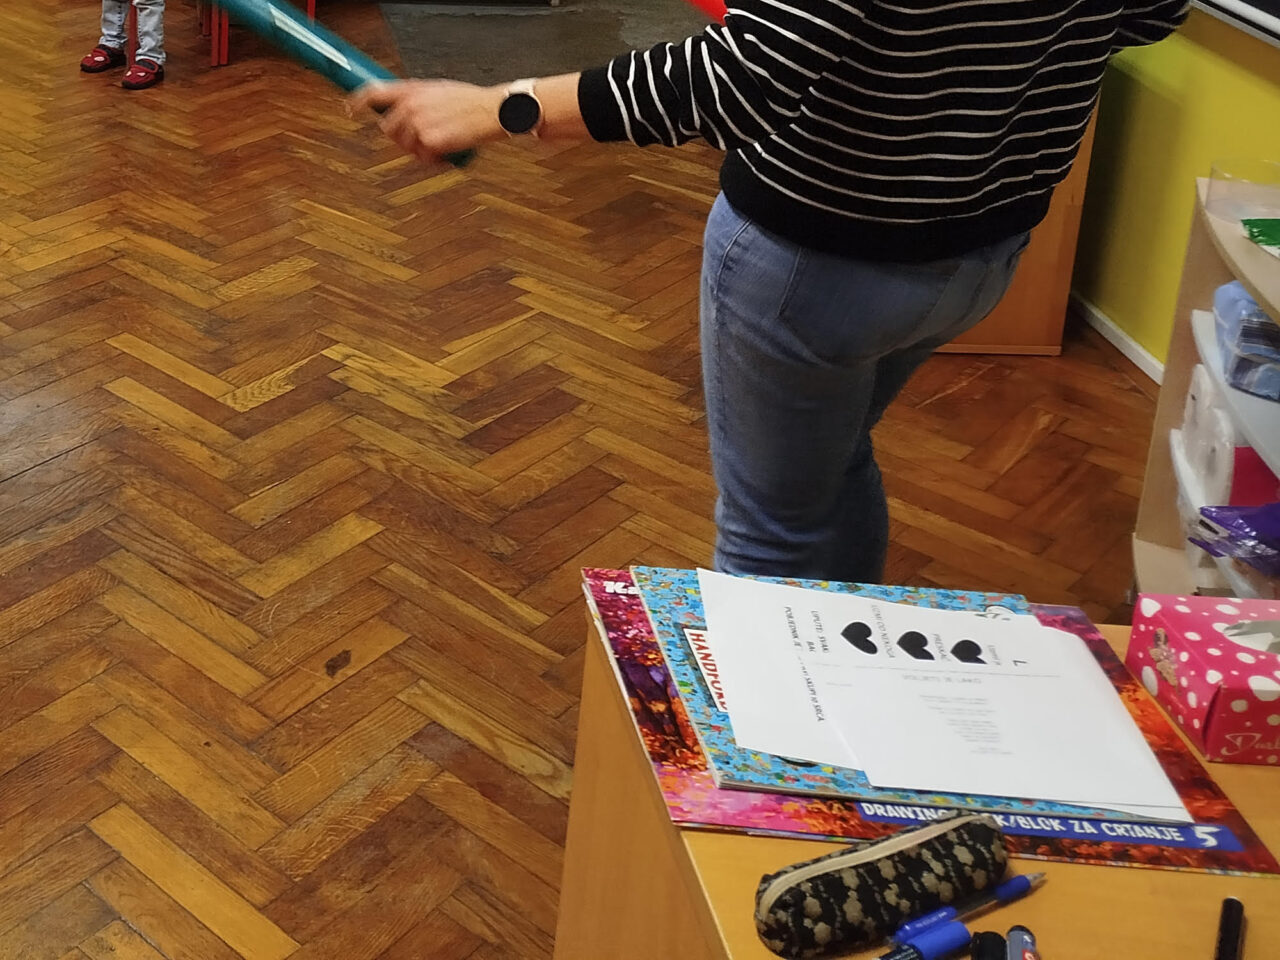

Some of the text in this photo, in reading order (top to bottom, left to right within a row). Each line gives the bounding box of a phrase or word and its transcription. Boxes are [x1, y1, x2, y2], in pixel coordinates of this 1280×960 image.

[1069, 819, 1099, 836] ZA
[1103, 823, 1186, 843] CRTANJE
[1193, 825, 1222, 848] 5
